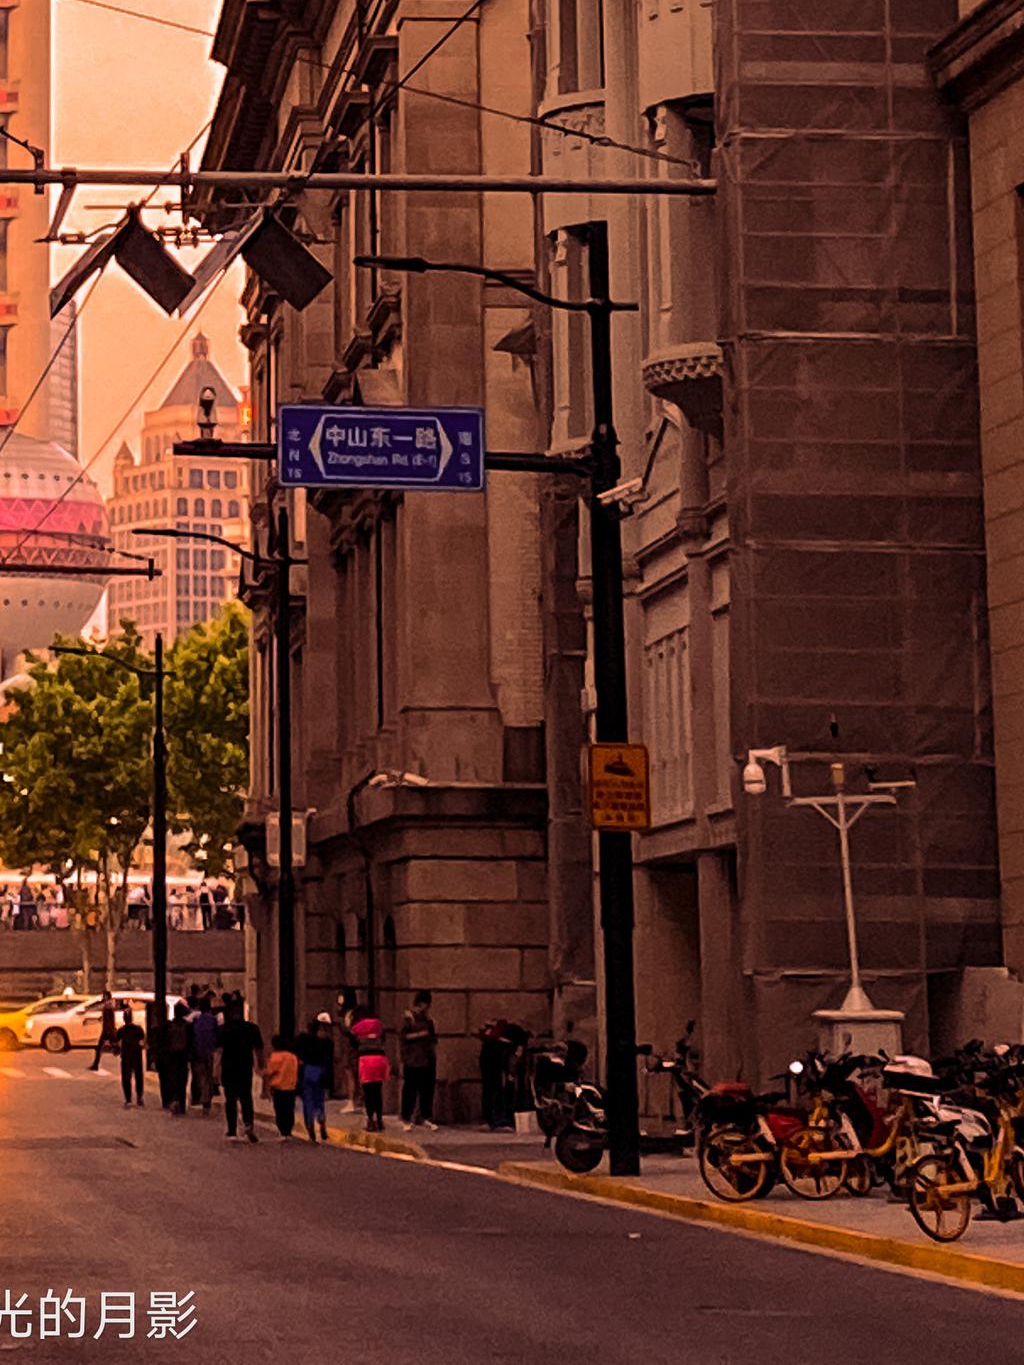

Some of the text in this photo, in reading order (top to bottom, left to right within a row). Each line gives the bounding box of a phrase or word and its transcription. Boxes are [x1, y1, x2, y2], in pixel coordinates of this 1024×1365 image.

[326, 424, 437, 449] 中山东一路
[288, 449, 300, 462] N
[327, 451, 388, 467] Zhongshan
